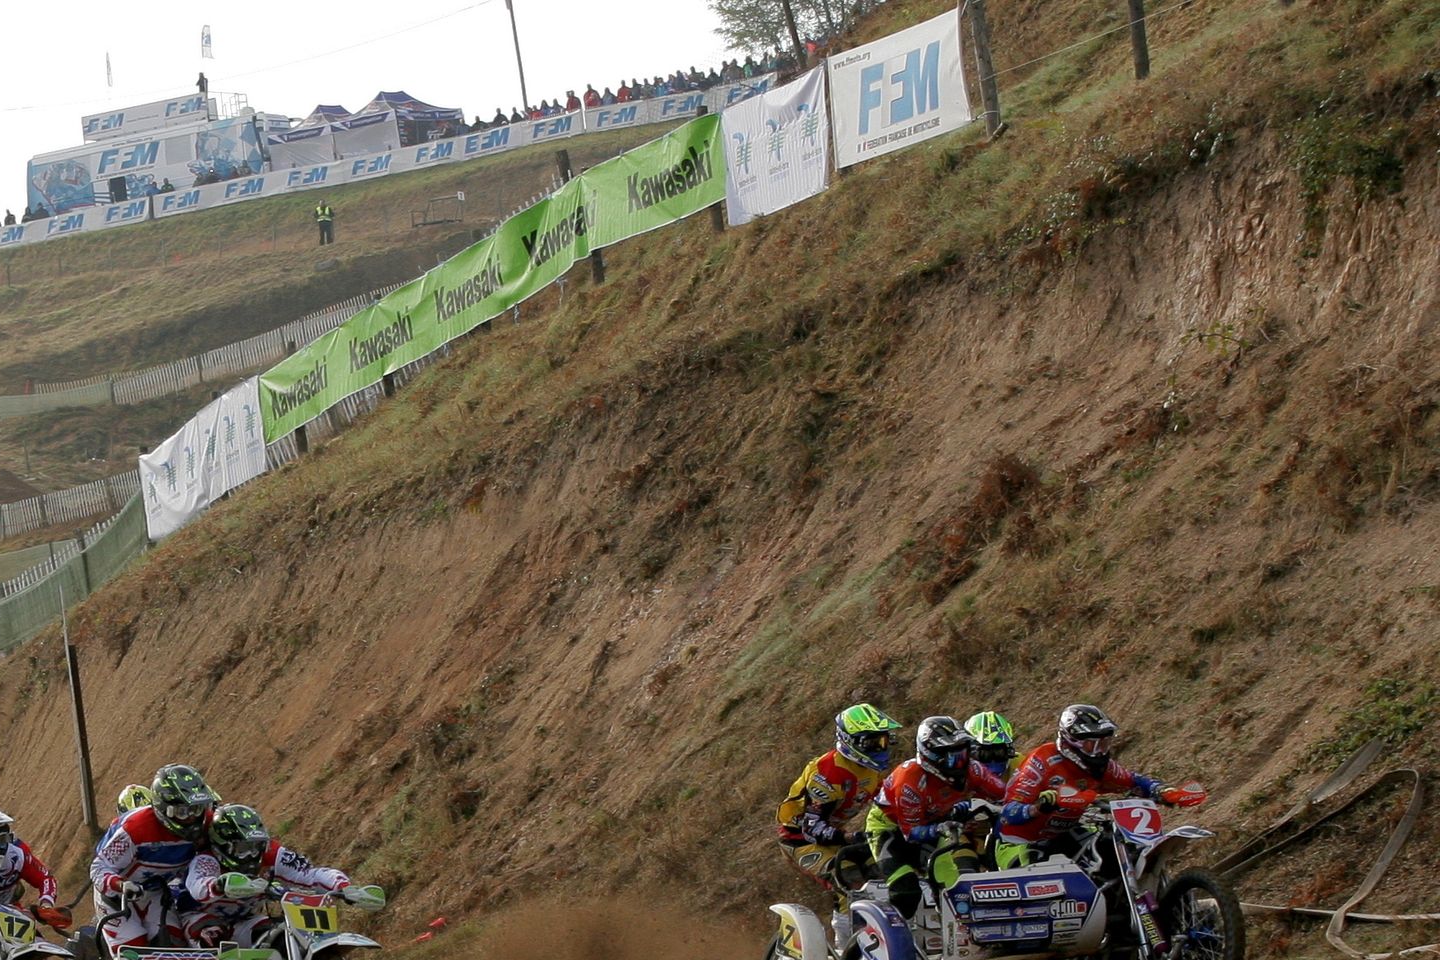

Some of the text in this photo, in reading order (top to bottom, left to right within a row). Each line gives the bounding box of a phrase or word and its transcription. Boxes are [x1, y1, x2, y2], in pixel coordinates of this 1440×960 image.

[627, 140, 713, 214] Kawasaki
[434, 254, 504, 324] Kawasaki
[349, 306, 415, 374] Kawasaki
[269, 356, 328, 421] Kawasaki
[1131, 808, 1154, 834] 2
[974, 889, 1018, 899] WILVO
[4, 916, 31, 939] 17
[300, 909, 331, 930] 11
[864, 933, 880, 960] 2
